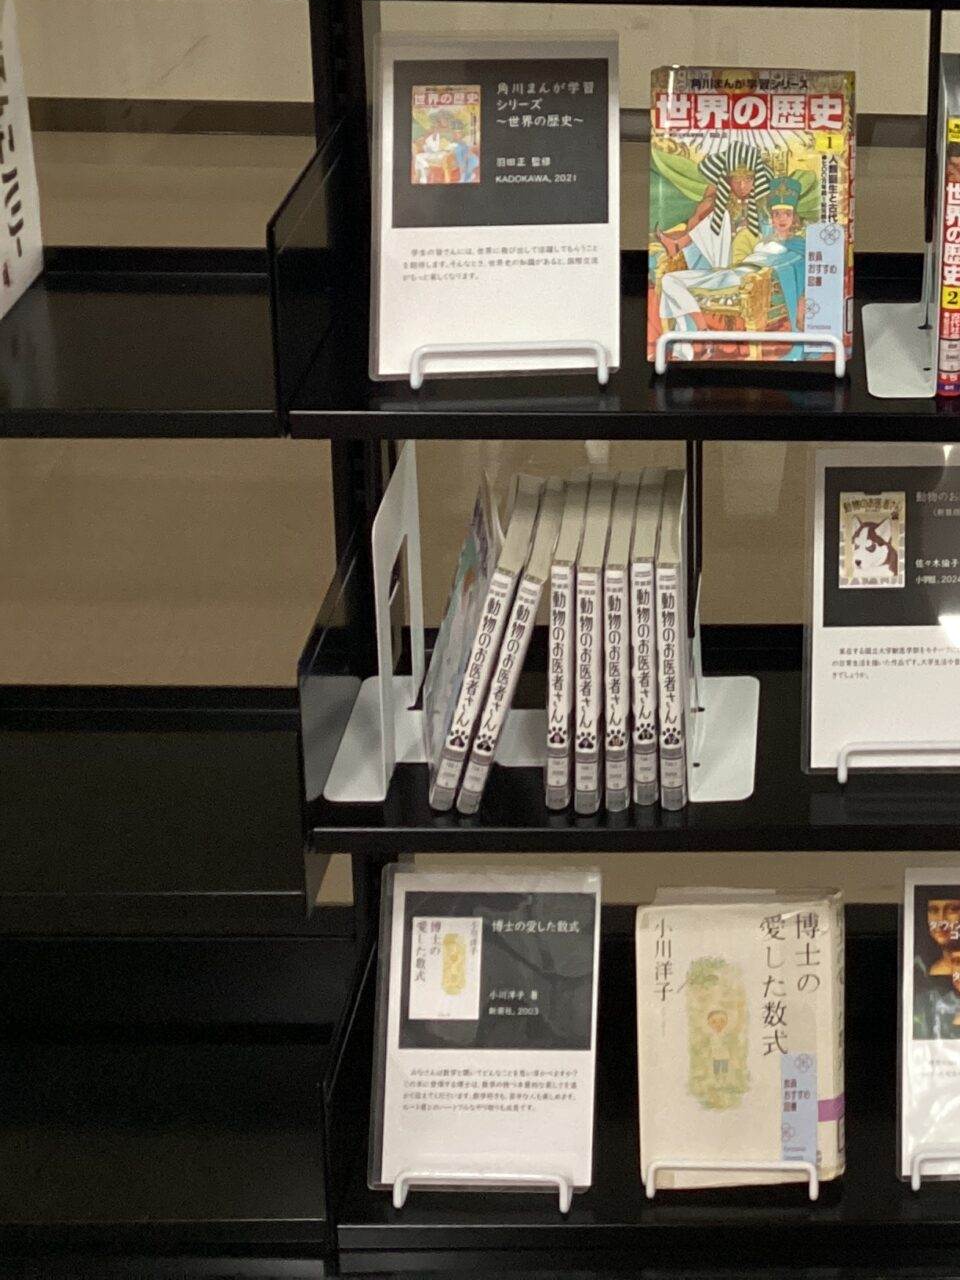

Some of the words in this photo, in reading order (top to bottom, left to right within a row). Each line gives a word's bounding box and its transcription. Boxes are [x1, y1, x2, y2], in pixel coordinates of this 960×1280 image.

[413, 92, 480, 106] 世界の歴史
[496, 81, 595, 95] 角川まんが学習
[496, 98, 541, 111] シリーズ
[656, 94, 844, 130] 世界の歴史
[554, 173, 577, 183] 2021
[826, 137, 833, 149] 1
[946, 292, 959, 305] 2
[455, 595, 502, 729] 動物のお医者さん
[482, 604, 531, 732] 動物のお医者さん
[551, 590, 567, 726] 動物のお医者さん
[579, 596, 593, 729] 動物のお医者さん
[607, 594, 623, 727] 動物のお医者さん
[635, 588, 651, 720] 動物のお医者さん
[661, 592, 677, 725] 動物のお医者さん
[491, 920, 580, 934] 博士の愛した数式
[654, 917, 674, 1002] 小川洋子
[795, 912, 821, 994] 博士の
[760, 915, 788, 1057] 愛した数式
